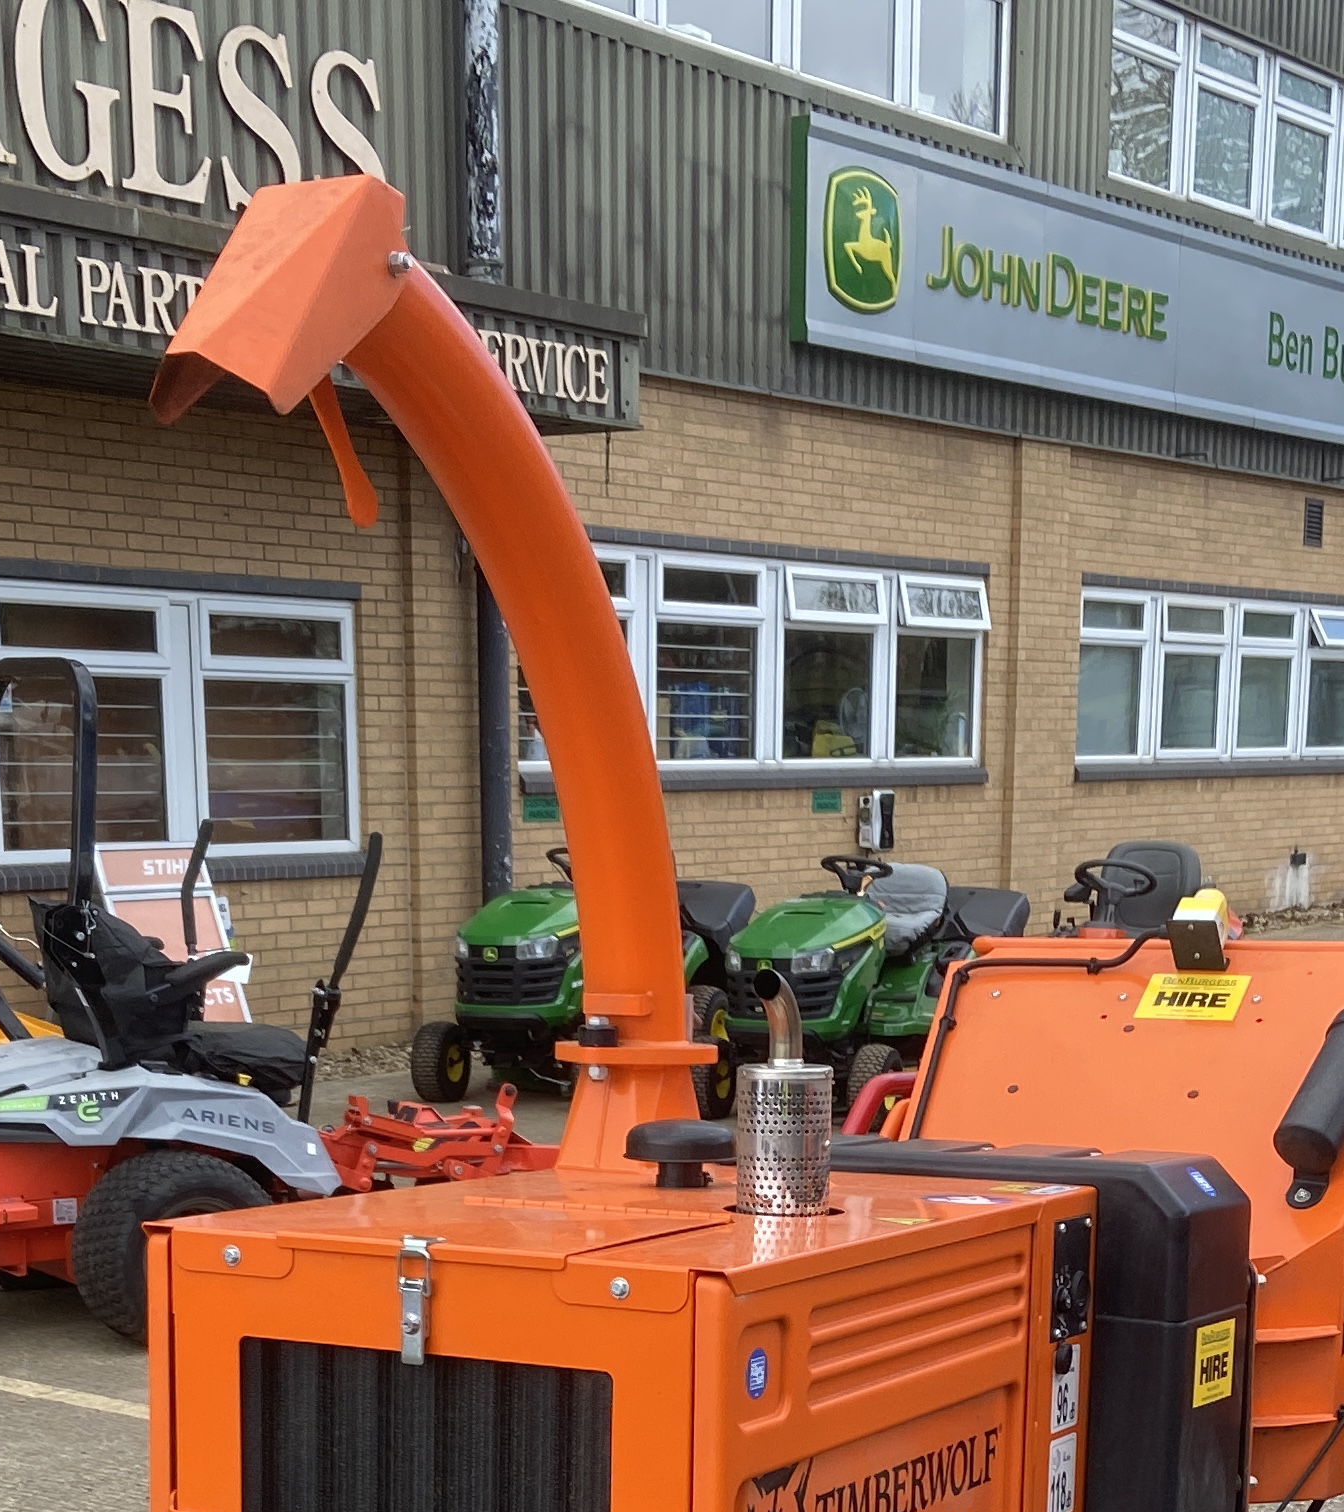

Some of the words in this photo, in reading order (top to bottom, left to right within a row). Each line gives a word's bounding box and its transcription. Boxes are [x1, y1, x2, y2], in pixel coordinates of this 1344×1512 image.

[926, 224, 1041, 312] JOHN
[1046, 251, 1169, 341] DEERE
[77, 256, 205, 336] PART
[475, 329, 609, 404] ERVICE
[1267, 310, 1314, 376] Ben
[1152, 991, 1232, 1009] HIRE
[58, 1091, 120, 1106] ZENITH
[181, 1107, 276, 1135] ARIENS
[1198, 1351, 1230, 1386] HIRE
[1056, 1382, 1069, 1426] 96
